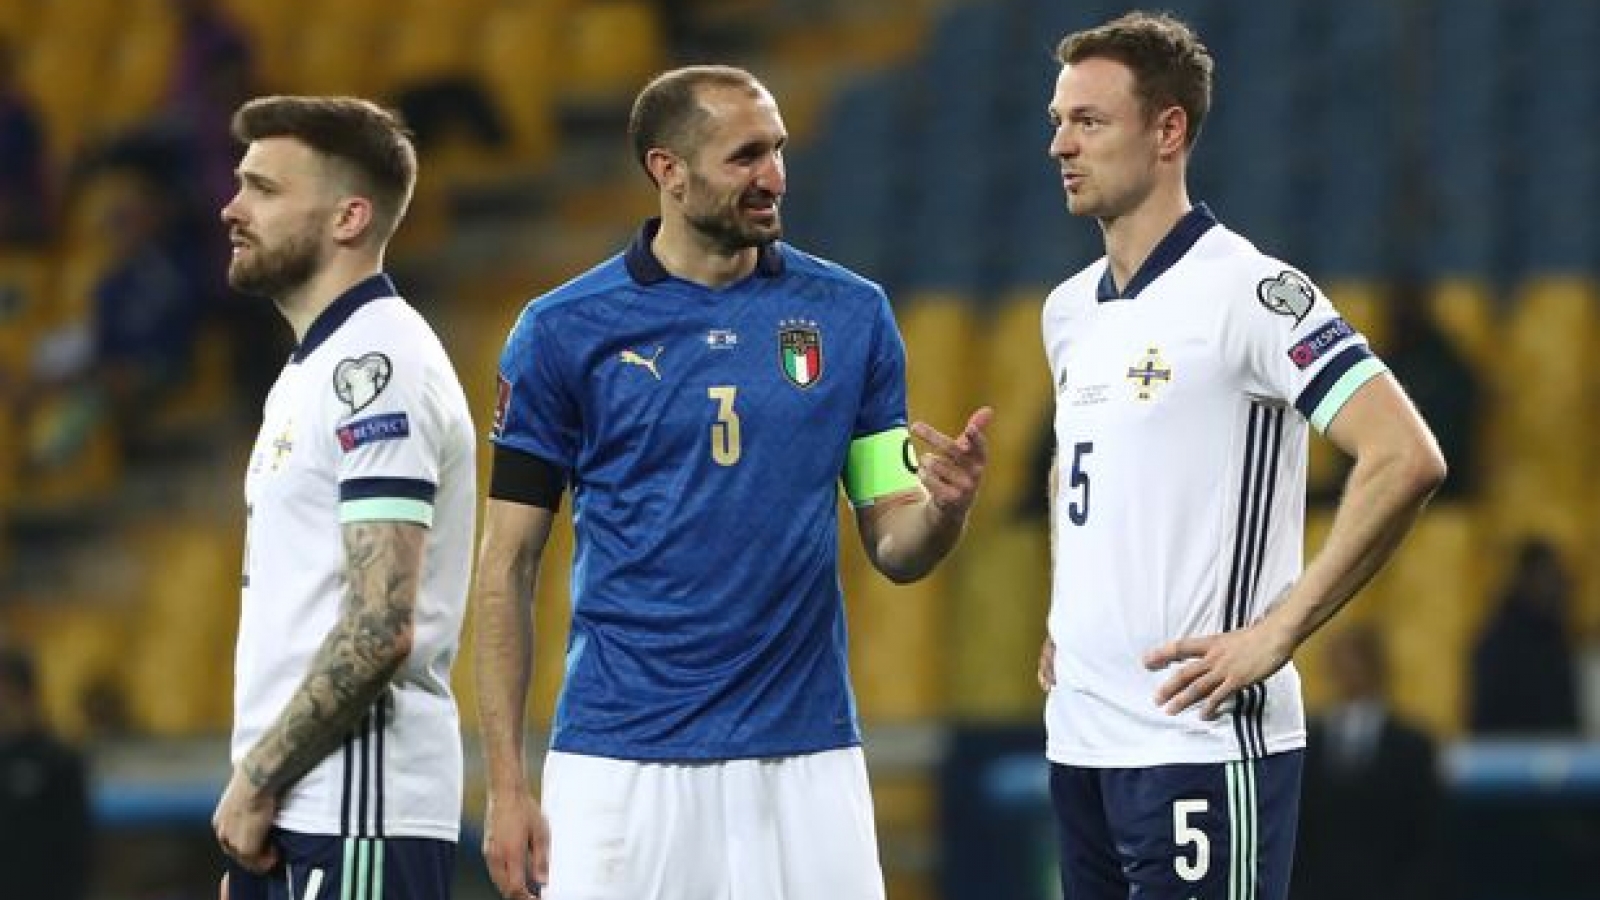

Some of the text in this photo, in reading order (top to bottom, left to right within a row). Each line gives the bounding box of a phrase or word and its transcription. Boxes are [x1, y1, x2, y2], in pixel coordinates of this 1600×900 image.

[707, 386, 741, 467] 3
[1068, 441, 1093, 527] 5
[1173, 799, 1210, 882] 5
